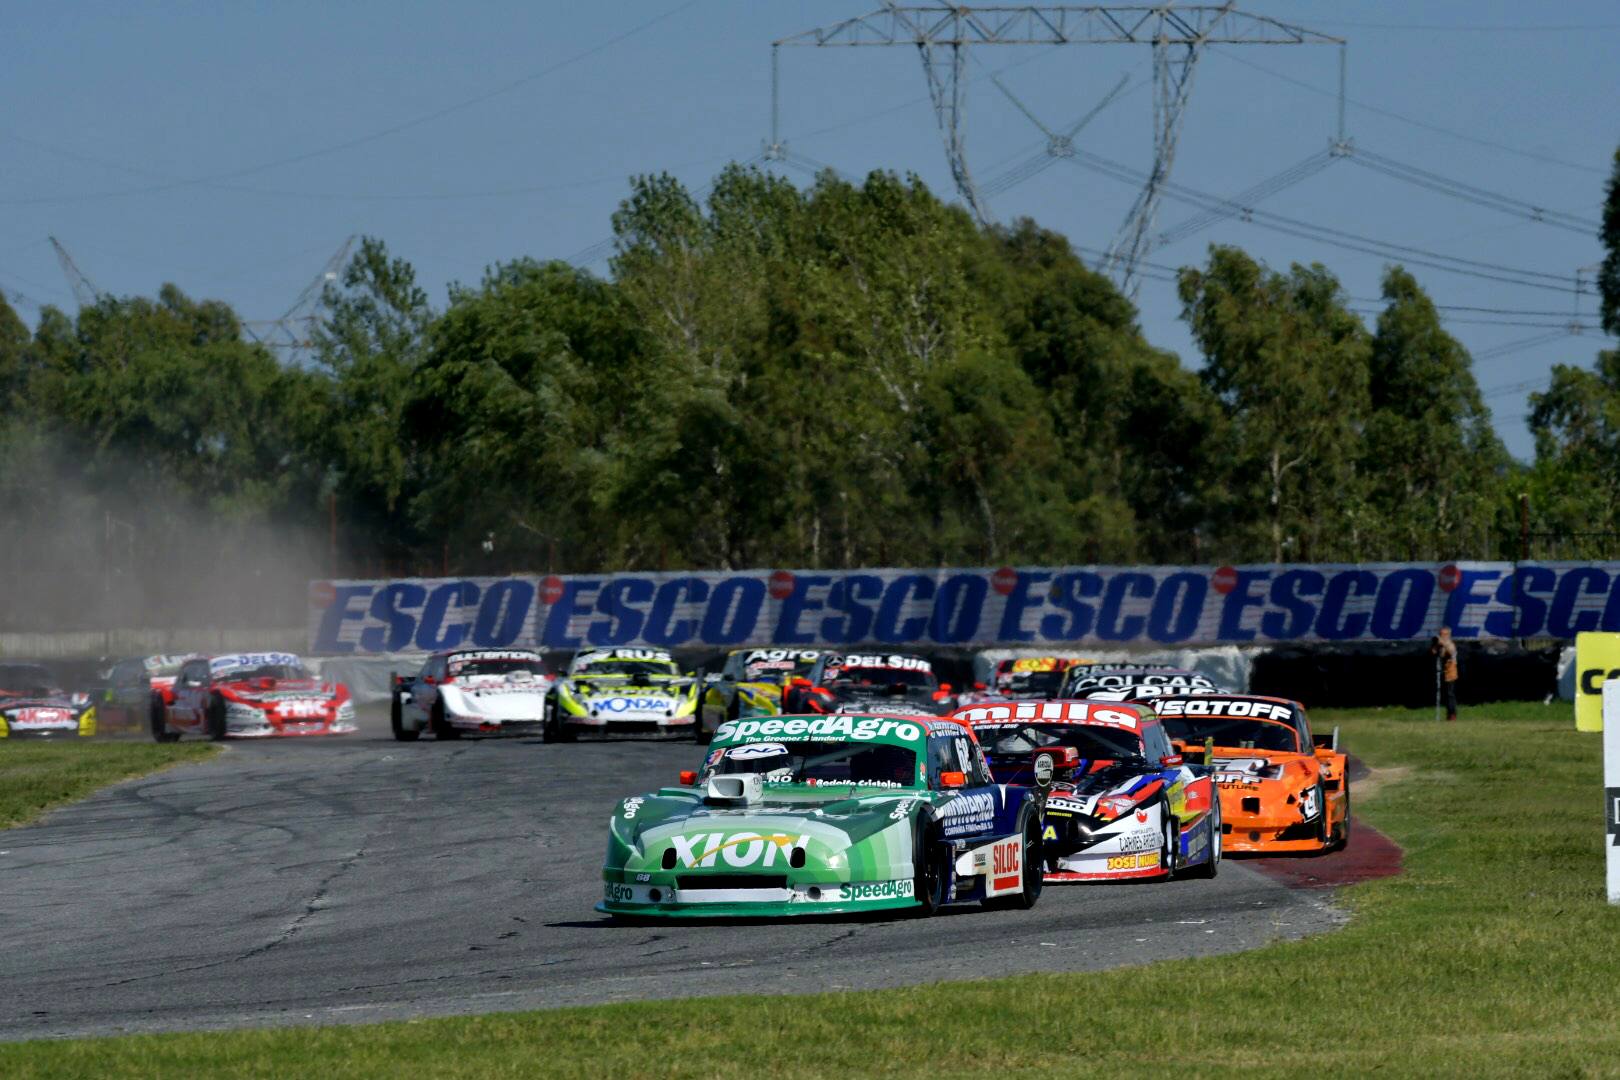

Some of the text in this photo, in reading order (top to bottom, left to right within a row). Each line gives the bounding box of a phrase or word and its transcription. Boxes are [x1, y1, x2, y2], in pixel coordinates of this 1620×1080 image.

[312, 580, 534, 653] ESCO
[541, 577, 766, 647] ESCO
[772, 574, 989, 644] ESCO
[997, 571, 1208, 643] ESCO
[1216, 569, 1435, 640] ESCO
[1443, 566, 1620, 637] ESC
[615, 650, 671, 661] RUS
[745, 650, 819, 663] Agro
[845, 655, 885, 668] DEL
[713, 716, 920, 742] SpeedAgro
[672, 832, 812, 868] XION
[993, 842, 1020, 875] SILOC
[1107, 854, 1137, 870] JOSE
[840, 881, 912, 901] SpeedAgro
